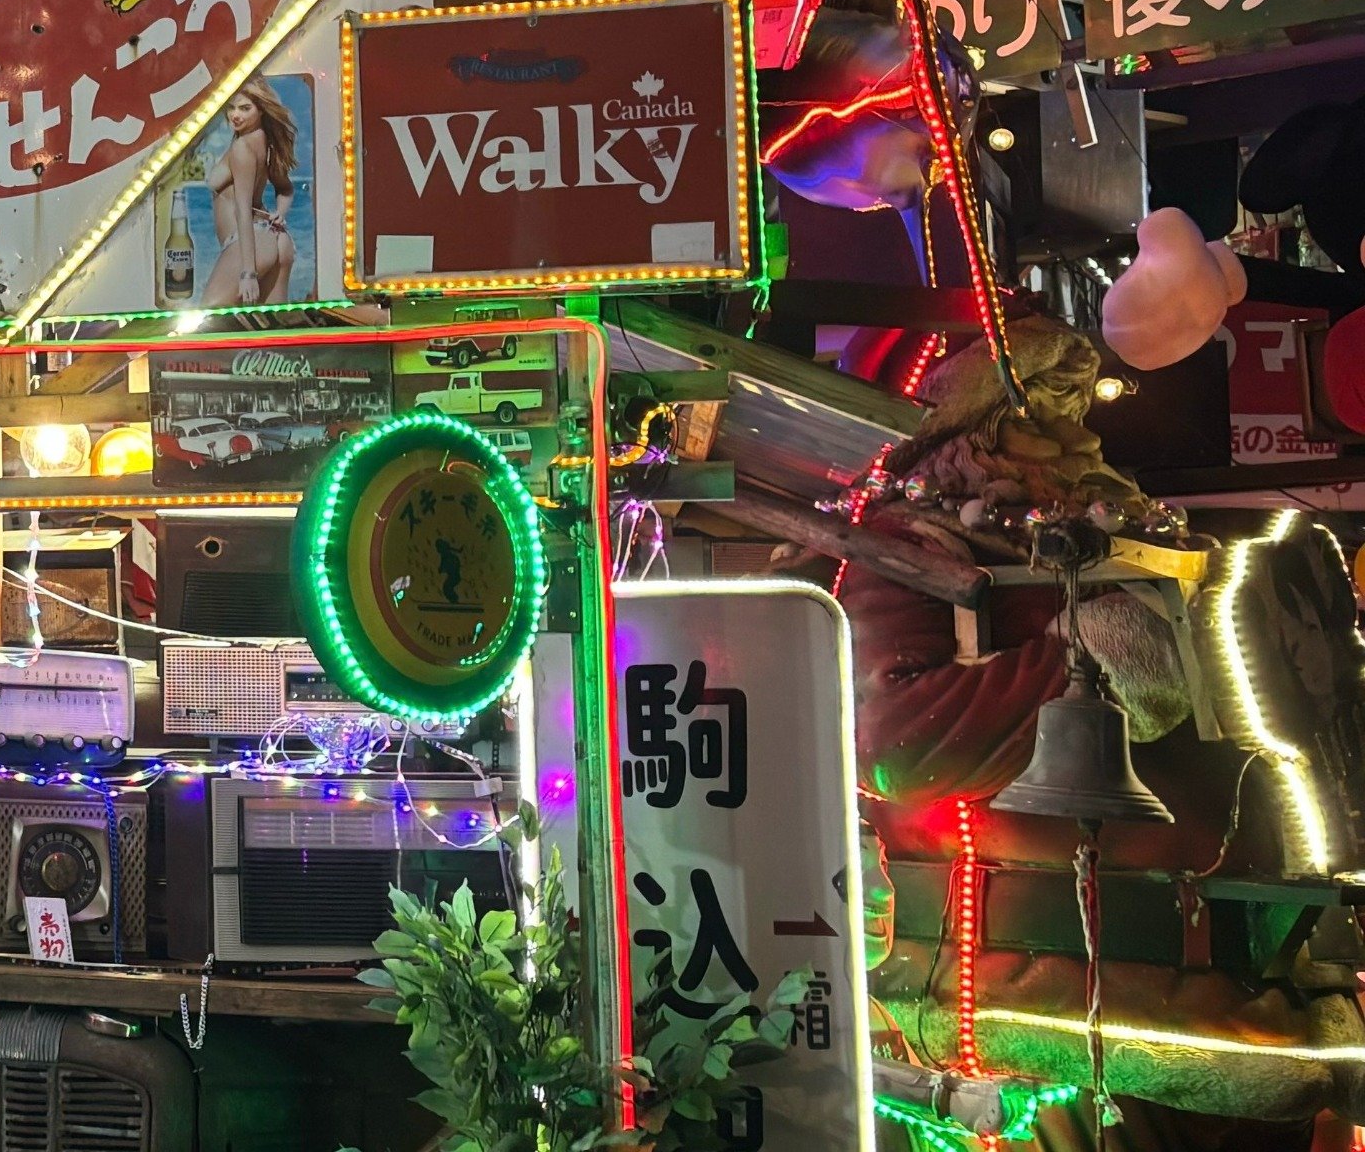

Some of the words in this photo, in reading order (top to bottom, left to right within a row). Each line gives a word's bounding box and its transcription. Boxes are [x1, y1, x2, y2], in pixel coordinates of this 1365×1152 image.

[602, 95, 697, 123] Canada
[382, 103, 699, 206] Walky
[416, 622, 452, 648] TRADE
[623, 659, 764, 1152] 駒込
